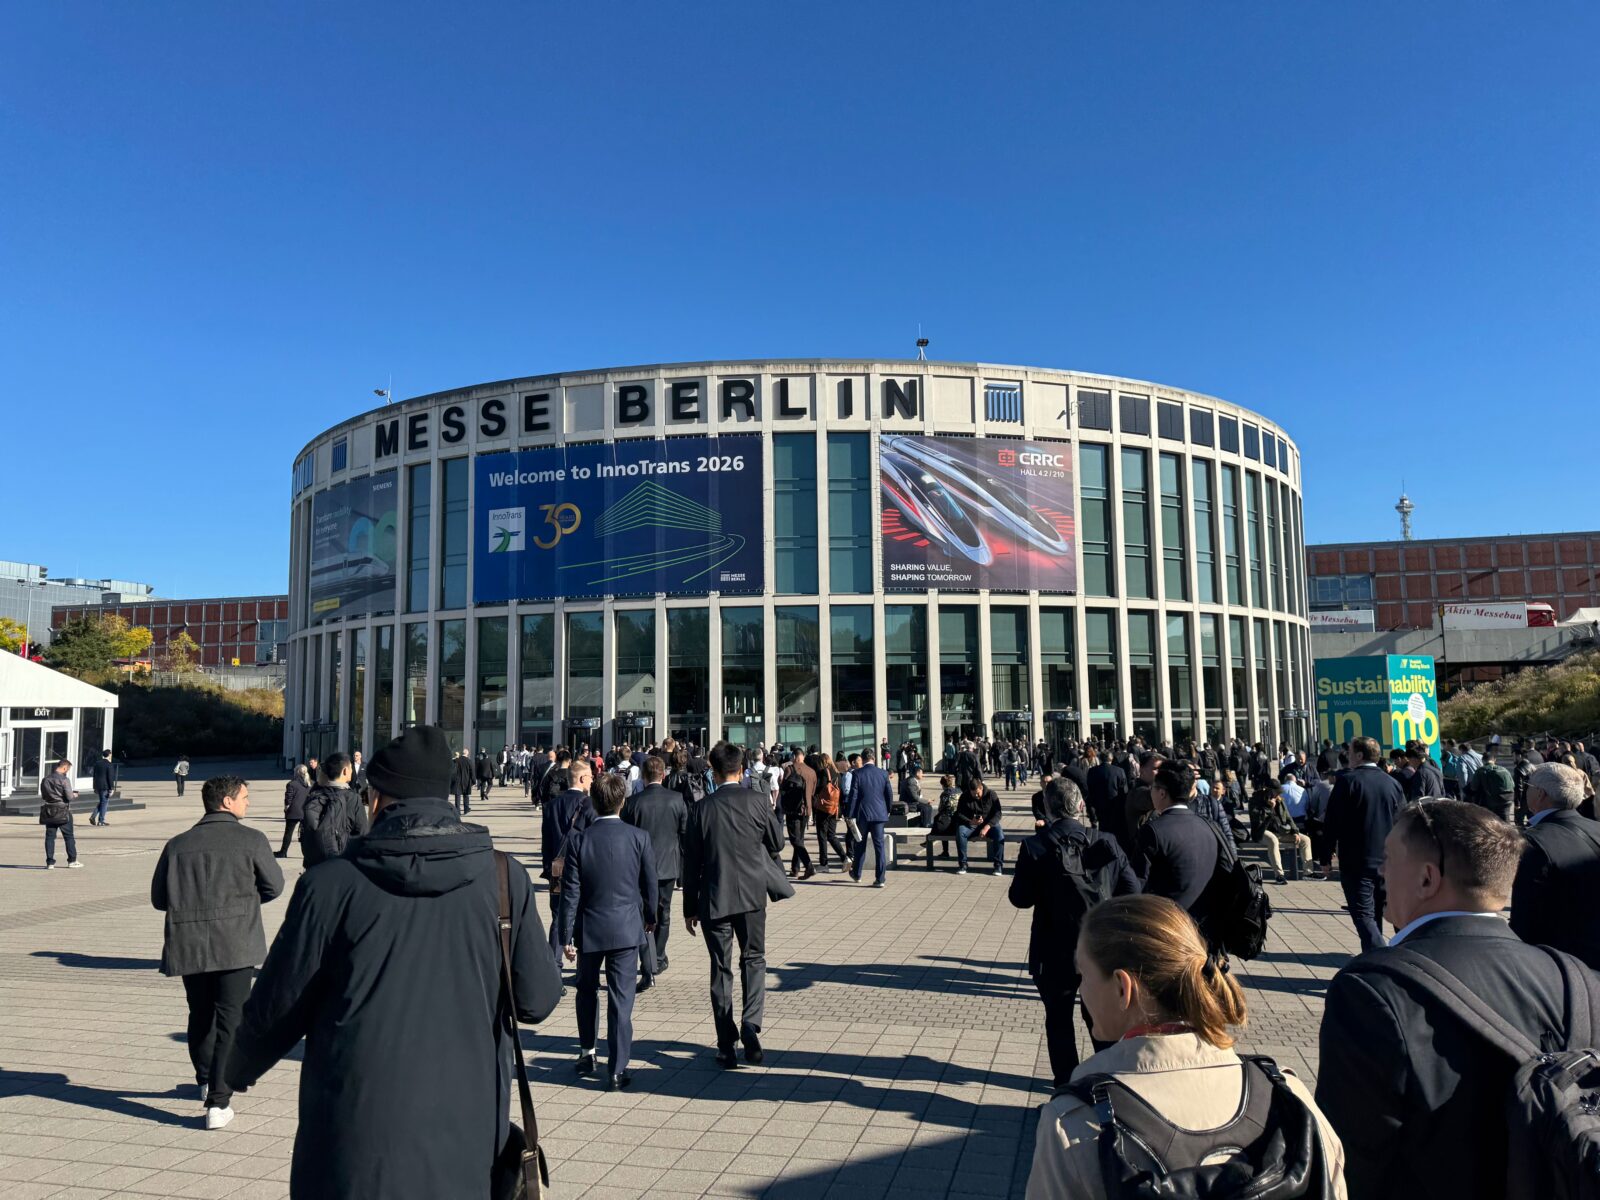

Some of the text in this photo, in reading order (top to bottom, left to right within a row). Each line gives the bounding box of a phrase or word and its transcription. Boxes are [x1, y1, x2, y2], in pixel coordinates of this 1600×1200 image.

[375, 379, 918, 458] MESSE BERLIN
[1019, 452, 1064, 467] CRRC
[489, 456, 745, 488] Welcome to InnoTrans 2026
[1020, 469, 1037, 477] HALL
[372, 481, 393, 491] SIEMENS
[492, 511, 522, 520] InnoTrans
[926, 564, 953, 572] VALUE,
[1445, 606, 1522, 620] Aktiv Messebau
[1321, 615, 1360, 625] Messebau
[1318, 675, 1435, 697] Sustainability
[34, 708, 51, 717] EXIT
[1318, 700, 1363, 746] in
